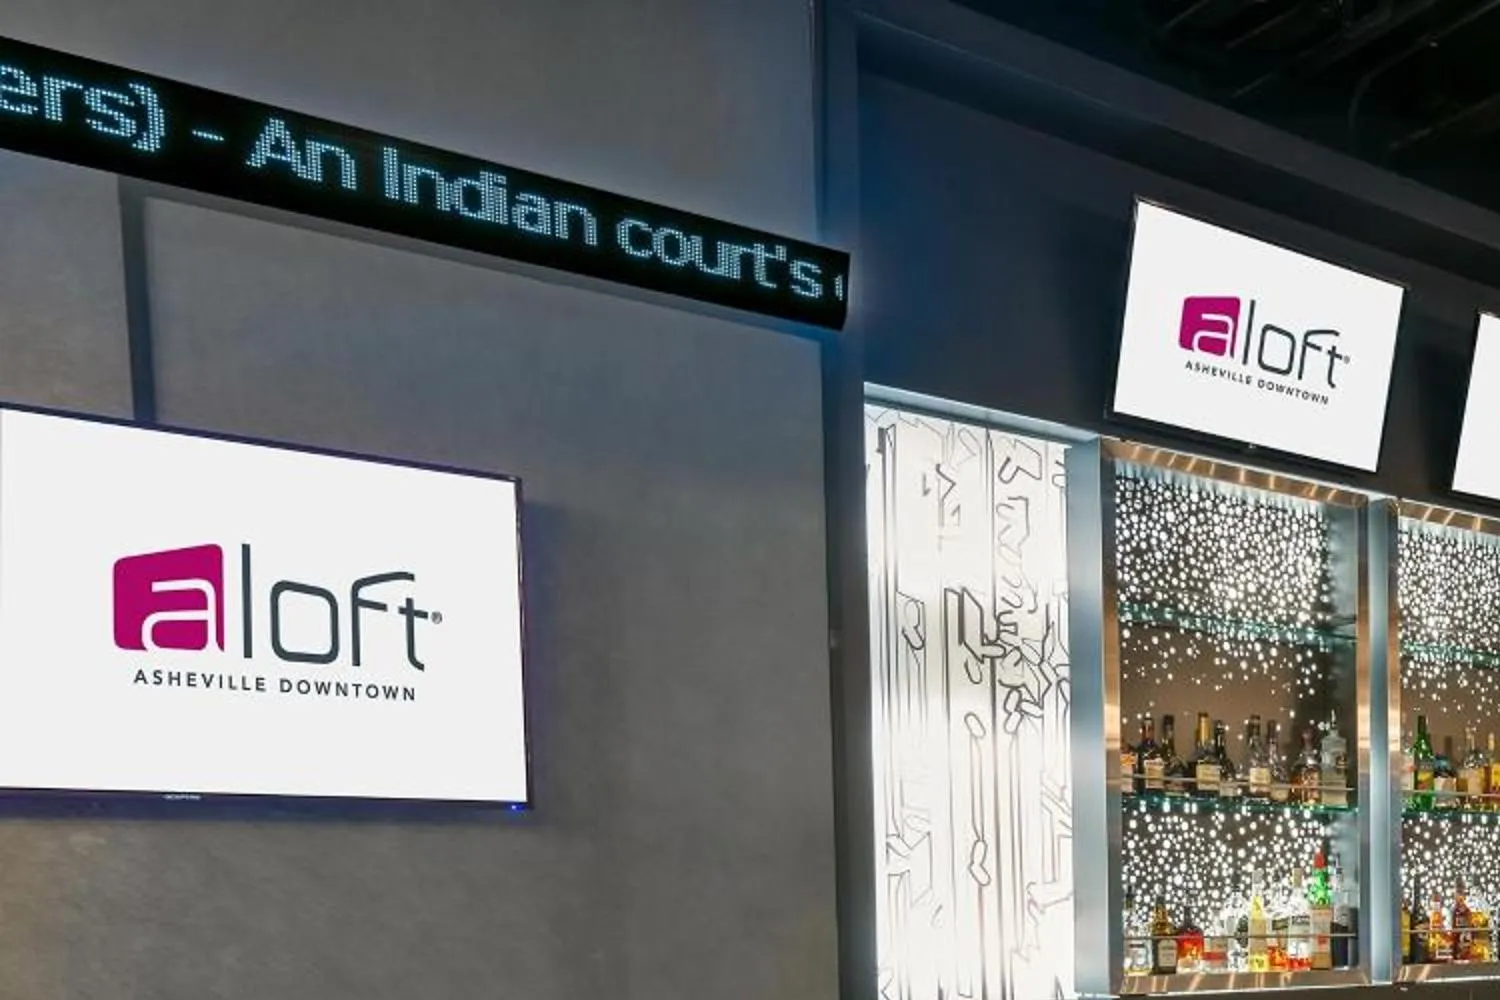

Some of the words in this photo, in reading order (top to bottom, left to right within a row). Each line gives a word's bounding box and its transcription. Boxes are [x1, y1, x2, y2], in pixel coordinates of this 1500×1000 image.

[246, 118, 357, 191] An
[383, 145, 598, 246] Indian
[615, 217, 823, 299] court's
[1179, 296, 1344, 389] aloft
[1185, 360, 1252, 385] ASHEVILLE
[1257, 378, 1330, 405] DOWNTOWN
[113, 543, 430, 673] aloft
[133, 668, 268, 693] ASHEVILLE
[278, 677, 417, 702] DOWNTOWN
